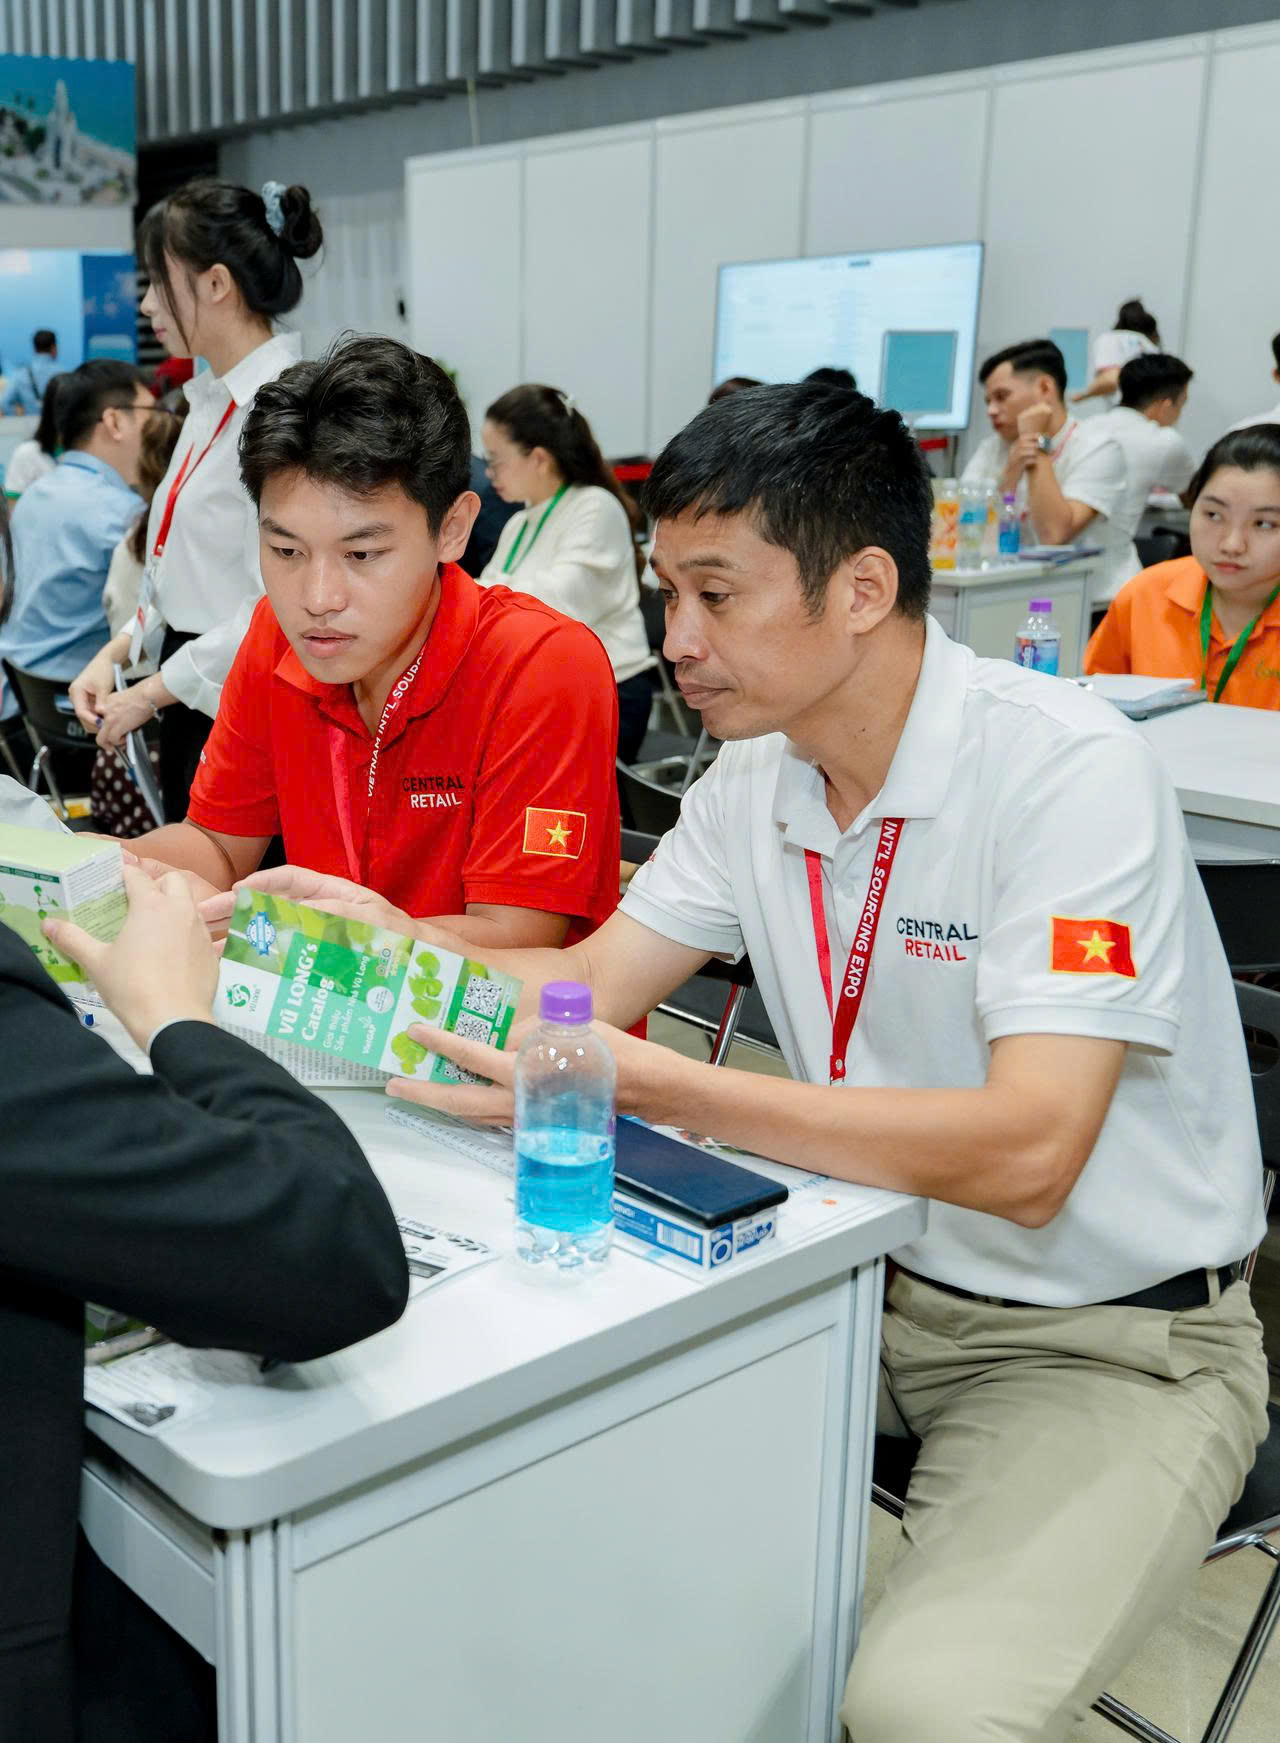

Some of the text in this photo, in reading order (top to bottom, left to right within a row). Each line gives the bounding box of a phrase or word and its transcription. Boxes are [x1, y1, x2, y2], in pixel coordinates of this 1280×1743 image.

[367, 736, 381, 797] VIETNAM
[378, 701, 398, 735] INT'L
[402, 775, 464, 792] CENTRAL
[410, 792, 463, 809] RETAIL
[844, 820, 898, 998] INT'L SOURCING EXPO
[896, 916, 979, 942] CENTRAL
[905, 938, 967, 962] RETAIL
[357, 956, 371, 976] Long
[301, 975, 335, 1041] Catalog
[277, 1008, 299, 1035] VŨ
